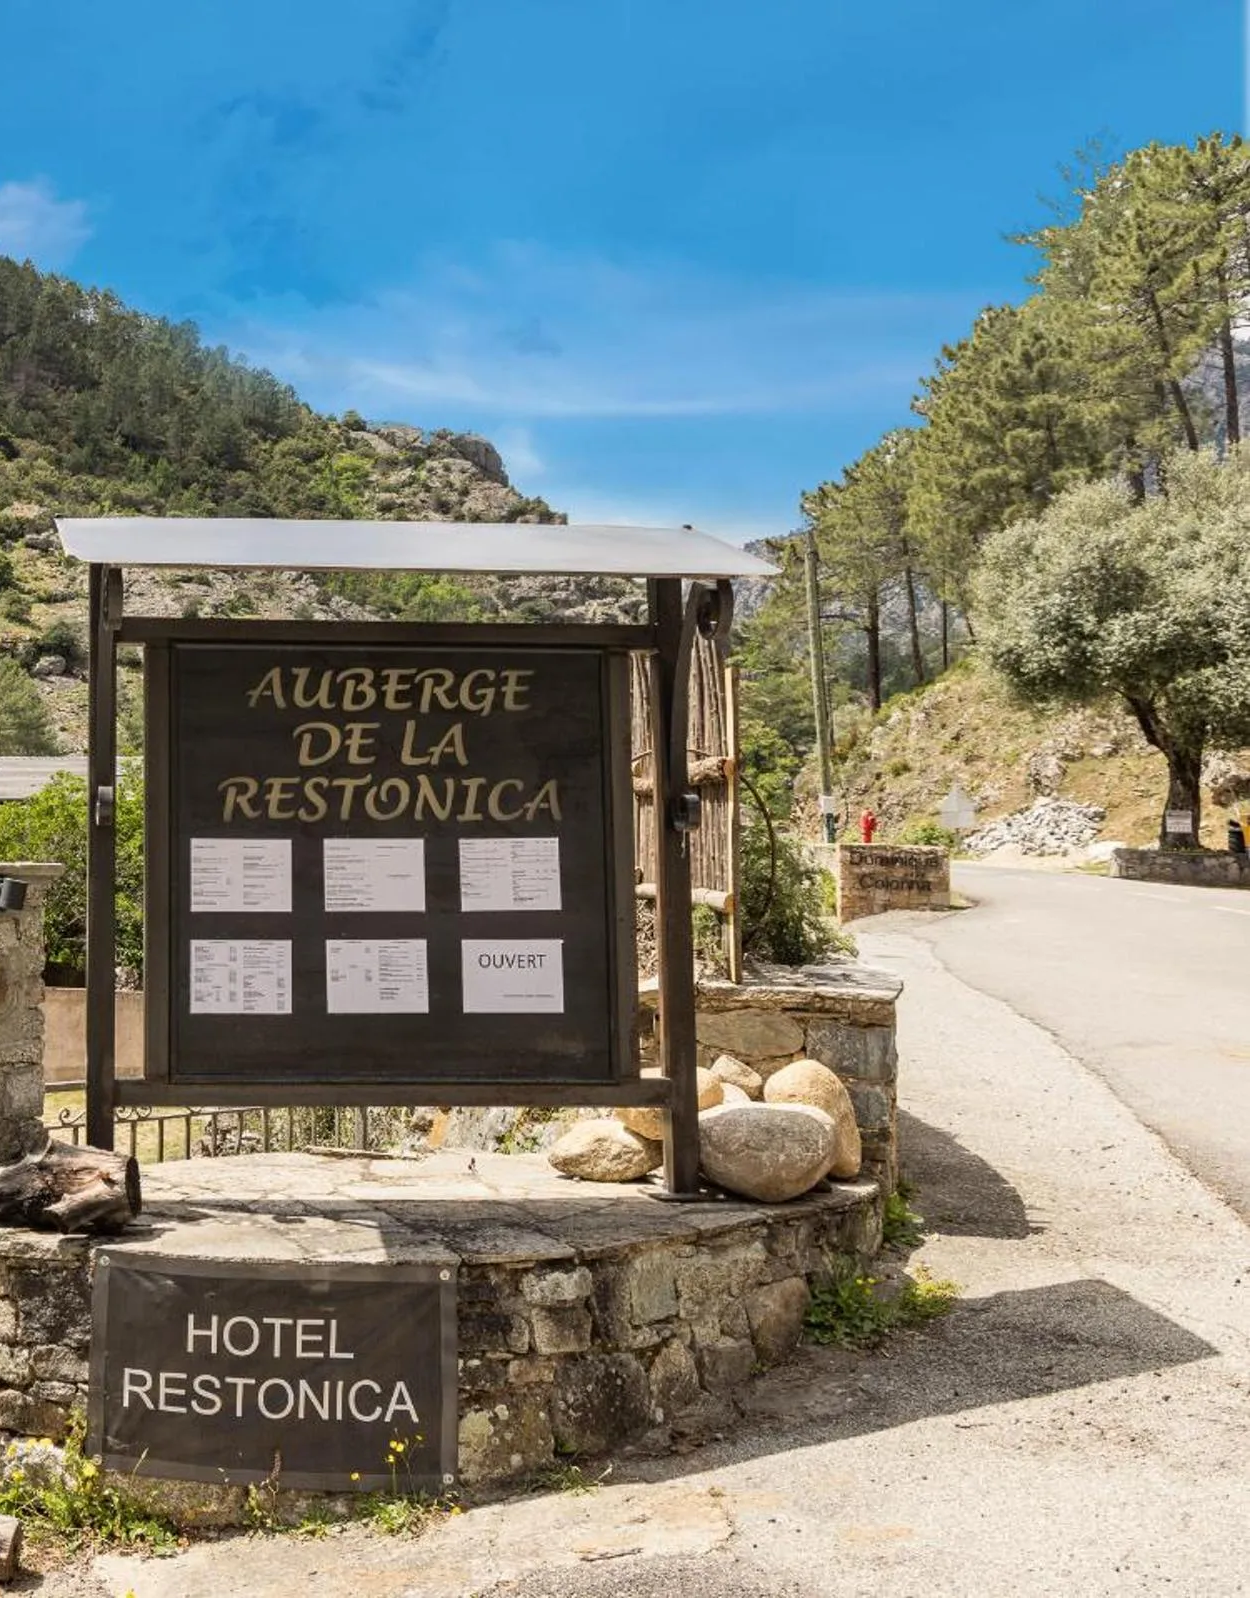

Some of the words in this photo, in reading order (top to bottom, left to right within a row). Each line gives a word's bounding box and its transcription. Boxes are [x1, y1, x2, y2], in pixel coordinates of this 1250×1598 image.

[246, 666, 536, 717] AUBERGE
[293, 721, 381, 766] DE
[400, 719, 470, 766] LA
[217, 773, 563, 823] RESTONICA
[478, 953, 547, 969] OUVERT
[186, 1313, 355, 1360] HOTEL
[121, 1367, 420, 1424] RESTONICA
